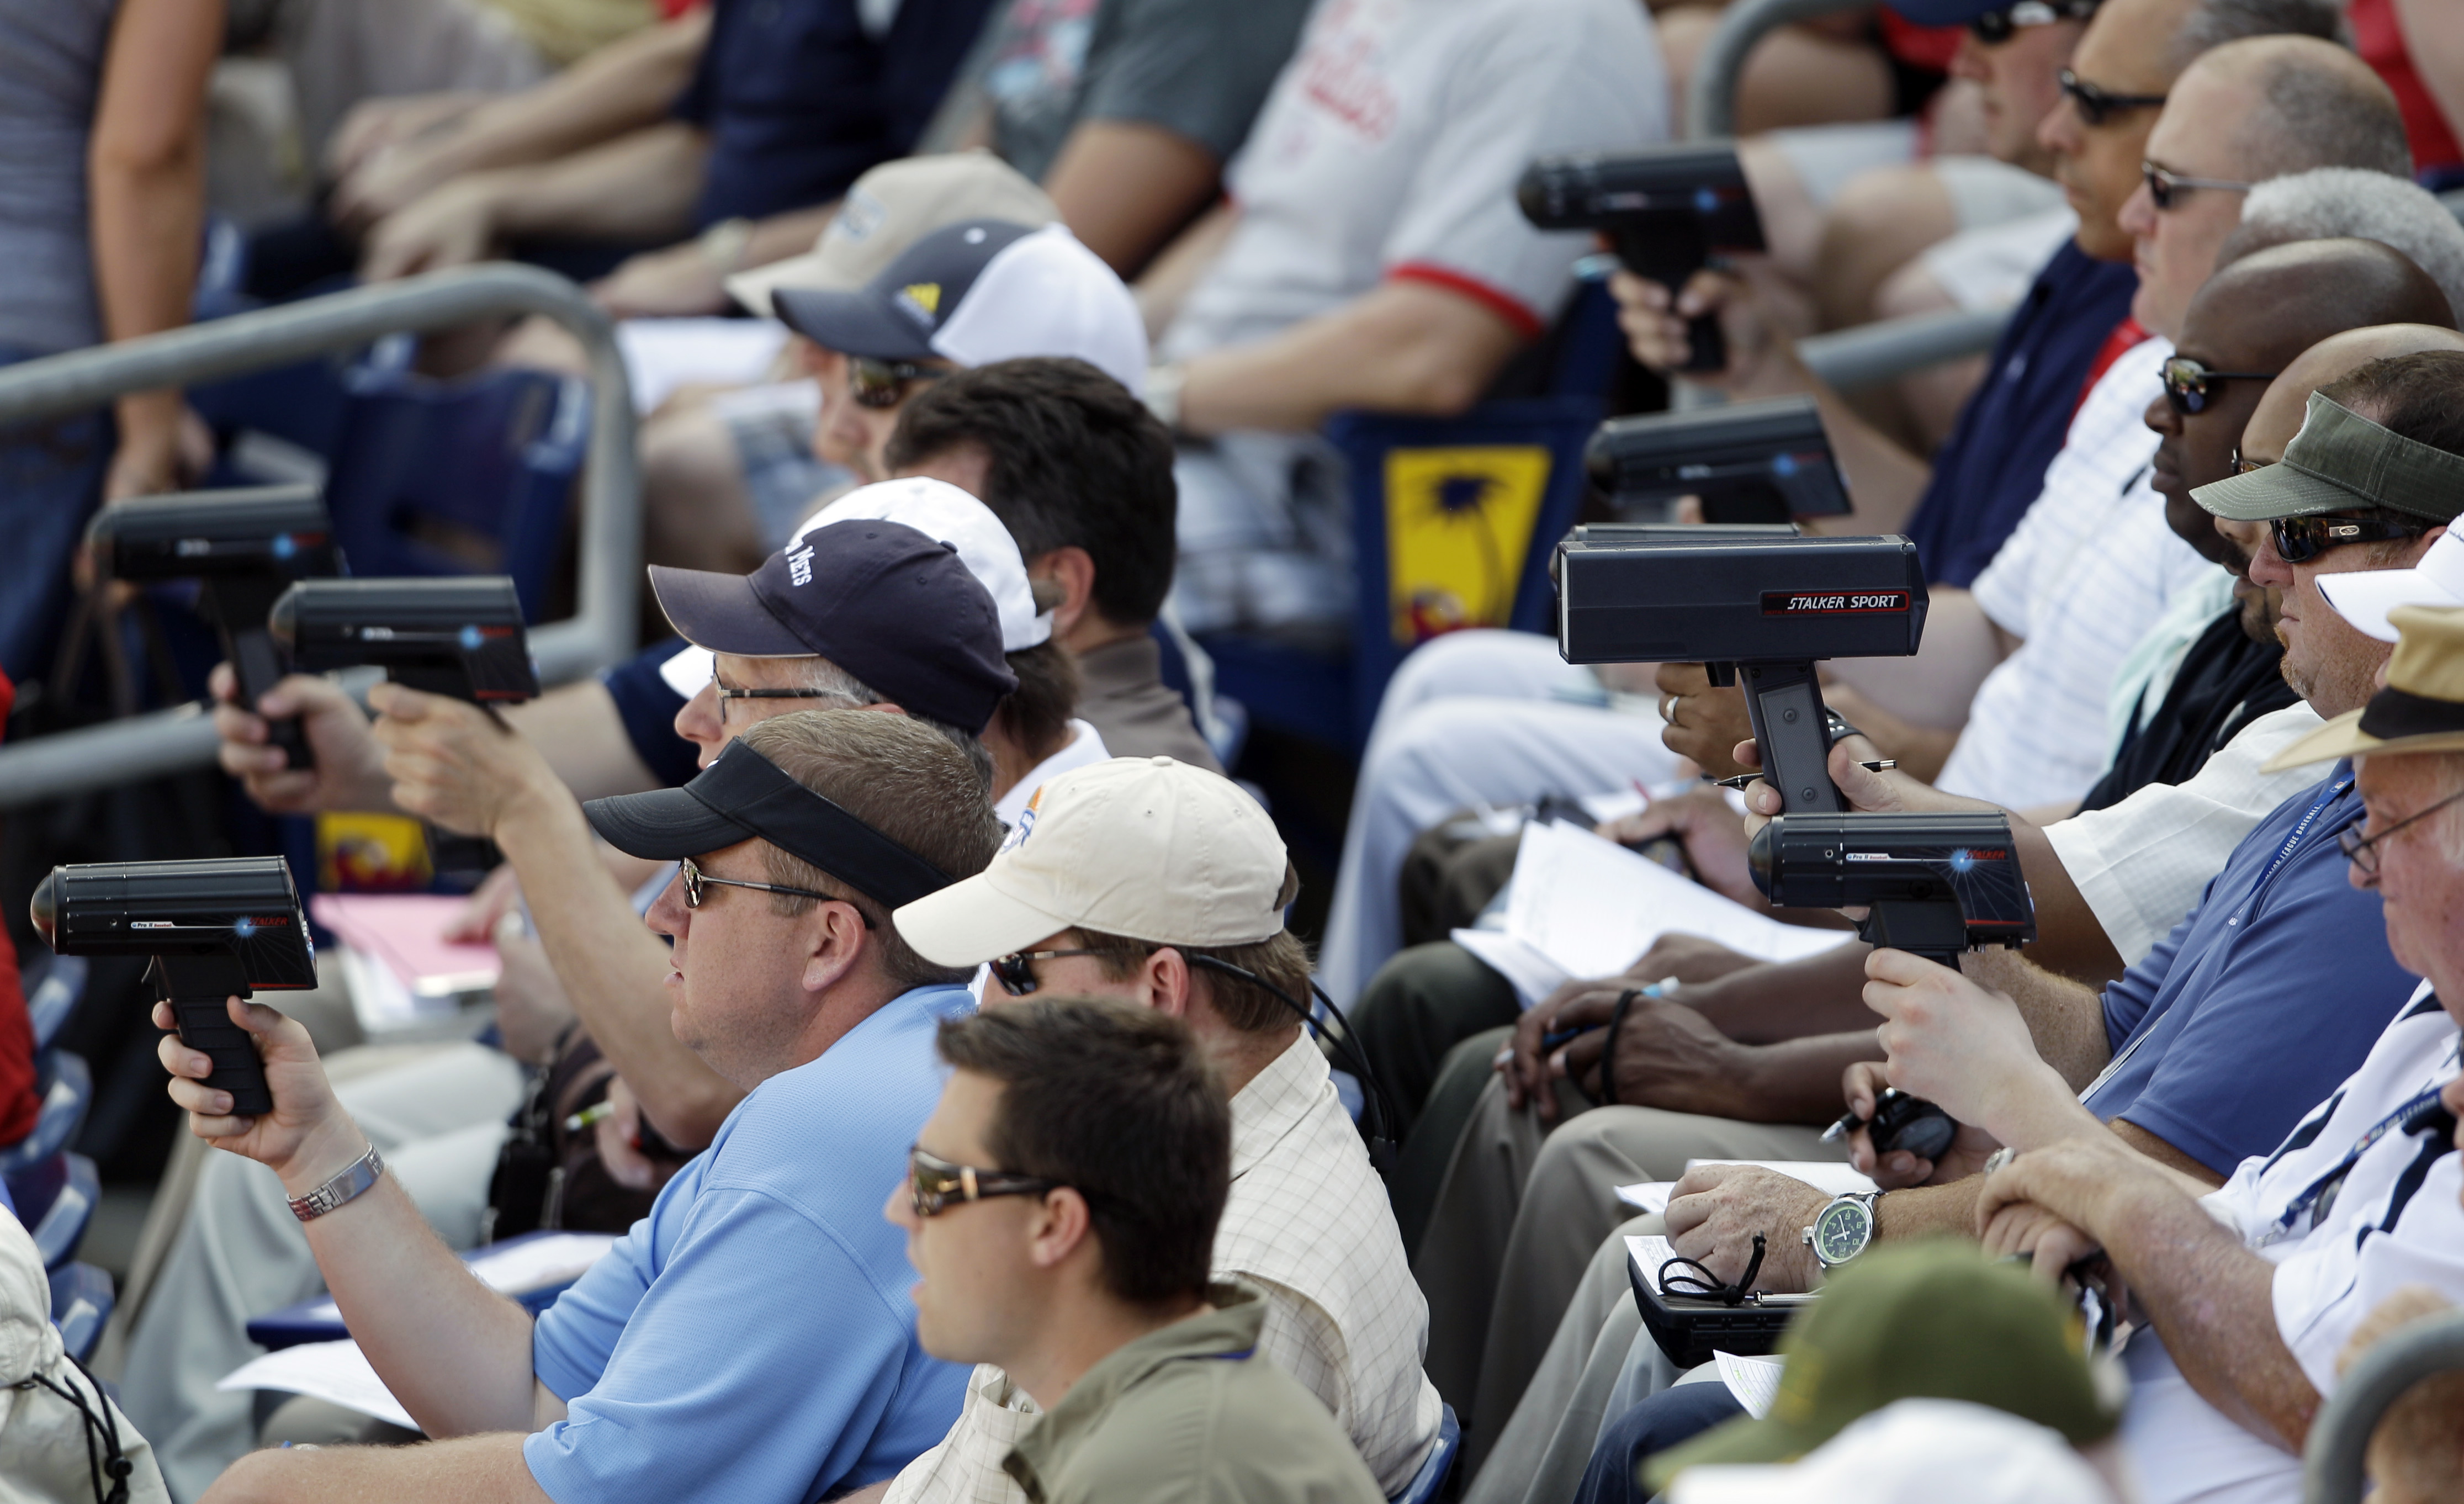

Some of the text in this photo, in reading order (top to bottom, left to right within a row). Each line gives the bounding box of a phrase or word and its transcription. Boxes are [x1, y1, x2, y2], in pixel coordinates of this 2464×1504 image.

[1787, 595, 1898, 610] STALKER SPORT
[2296, 806, 2321, 835] BASEBALL
[1965, 850, 2006, 860] STALKER
[247, 917, 289, 926] STALKER
